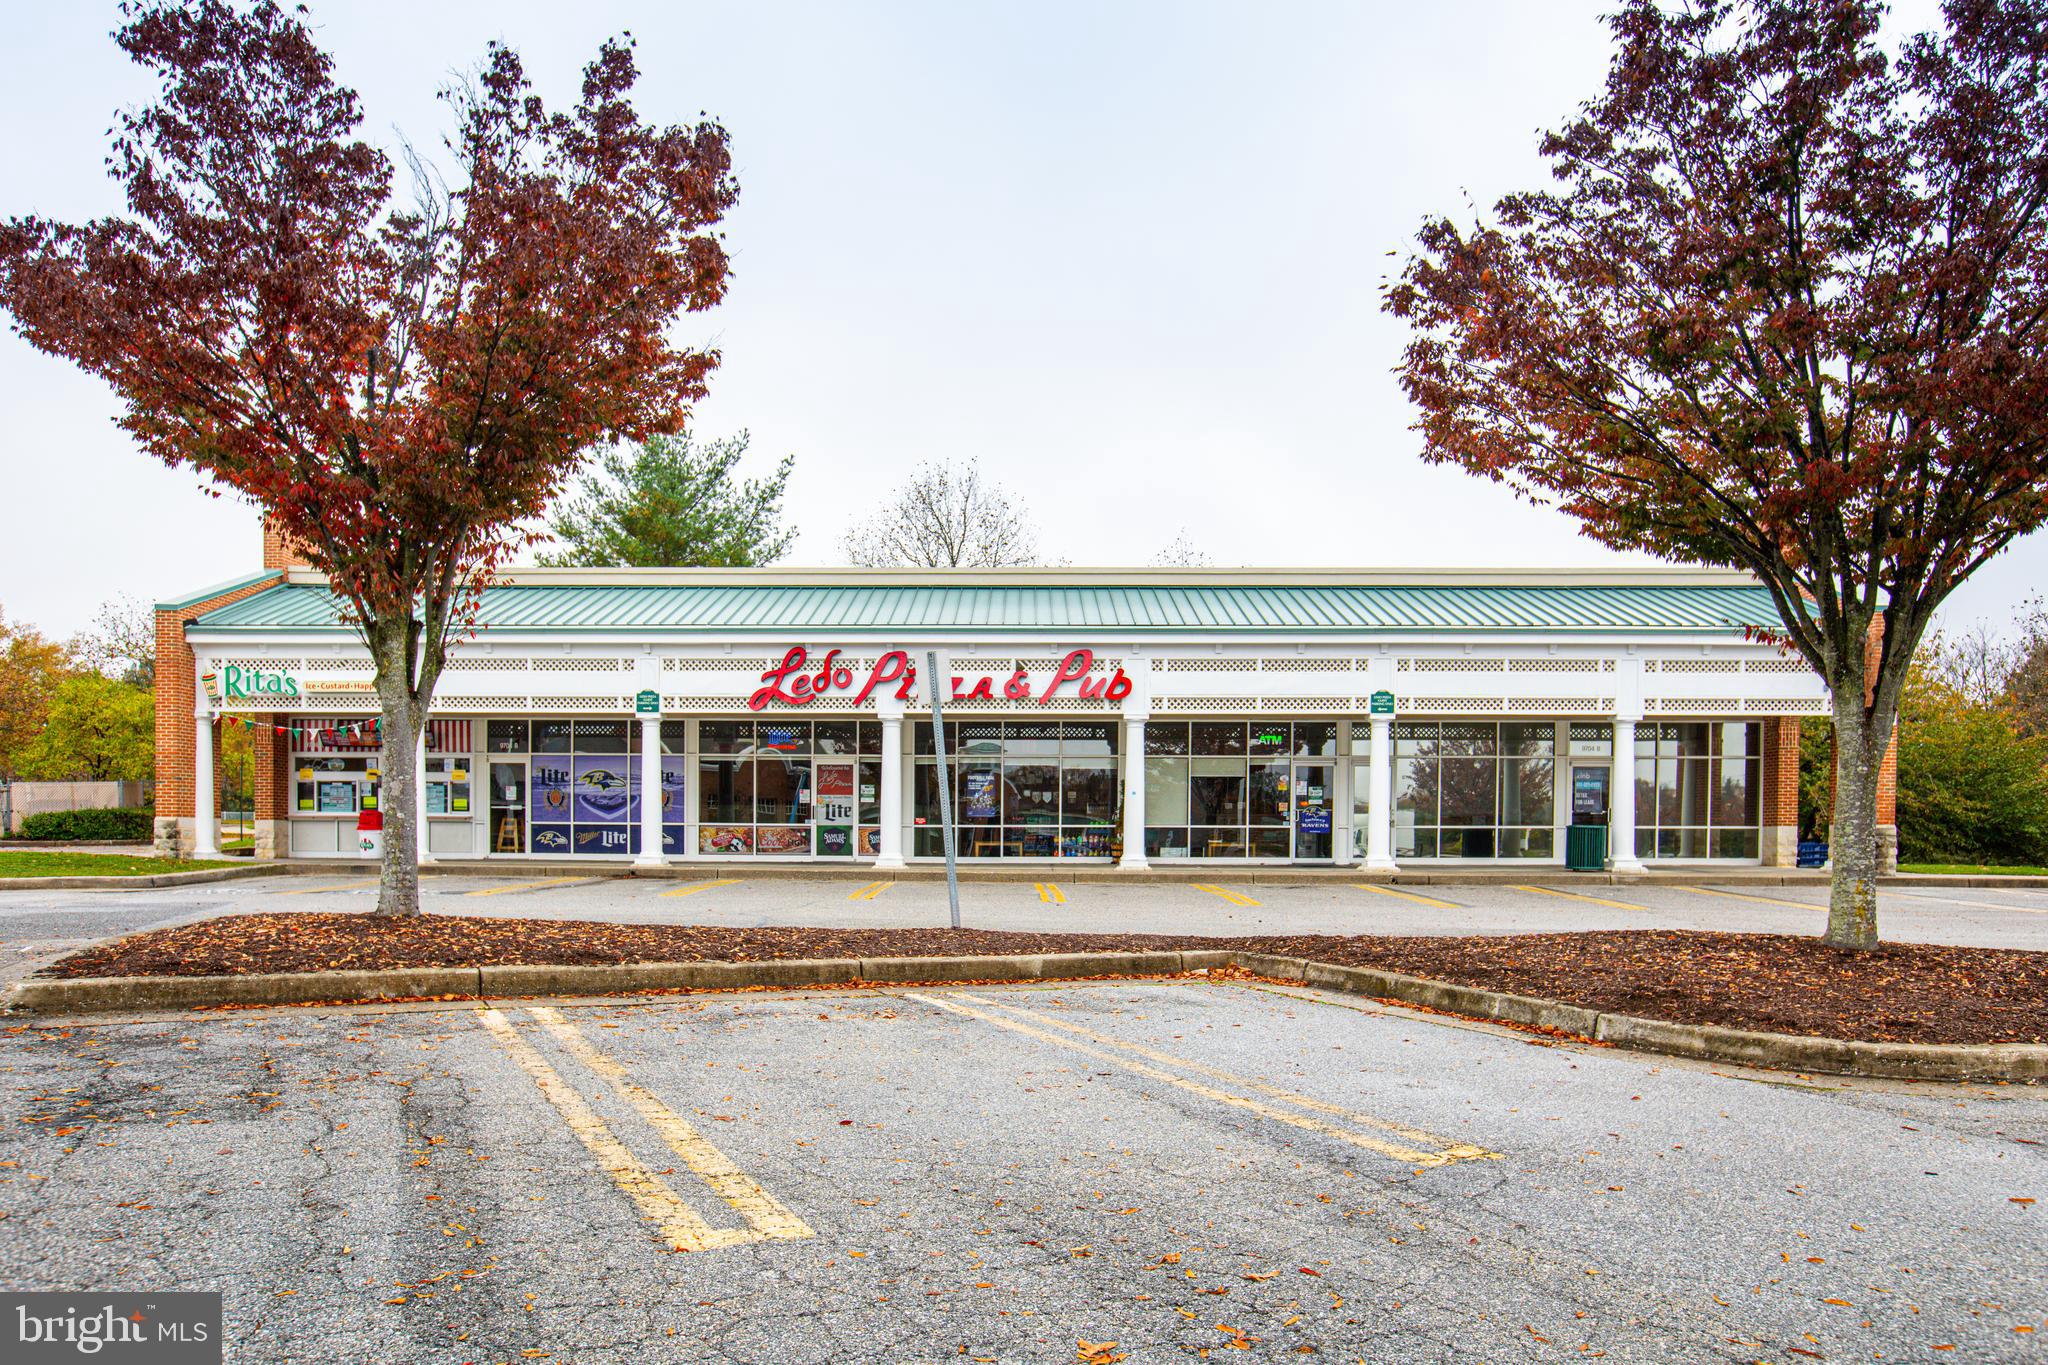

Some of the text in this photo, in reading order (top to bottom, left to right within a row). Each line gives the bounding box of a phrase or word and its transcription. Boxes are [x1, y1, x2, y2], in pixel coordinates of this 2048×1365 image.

[224, 665, 298, 698] Rita's
[748, 646, 1133, 711] Ledo Piza & Pub
[1259, 735, 1282, 745] ATM
[540, 768, 569, 786] Lite
[825, 803, 852, 821] Lite
[601, 830, 627, 847] Lite
